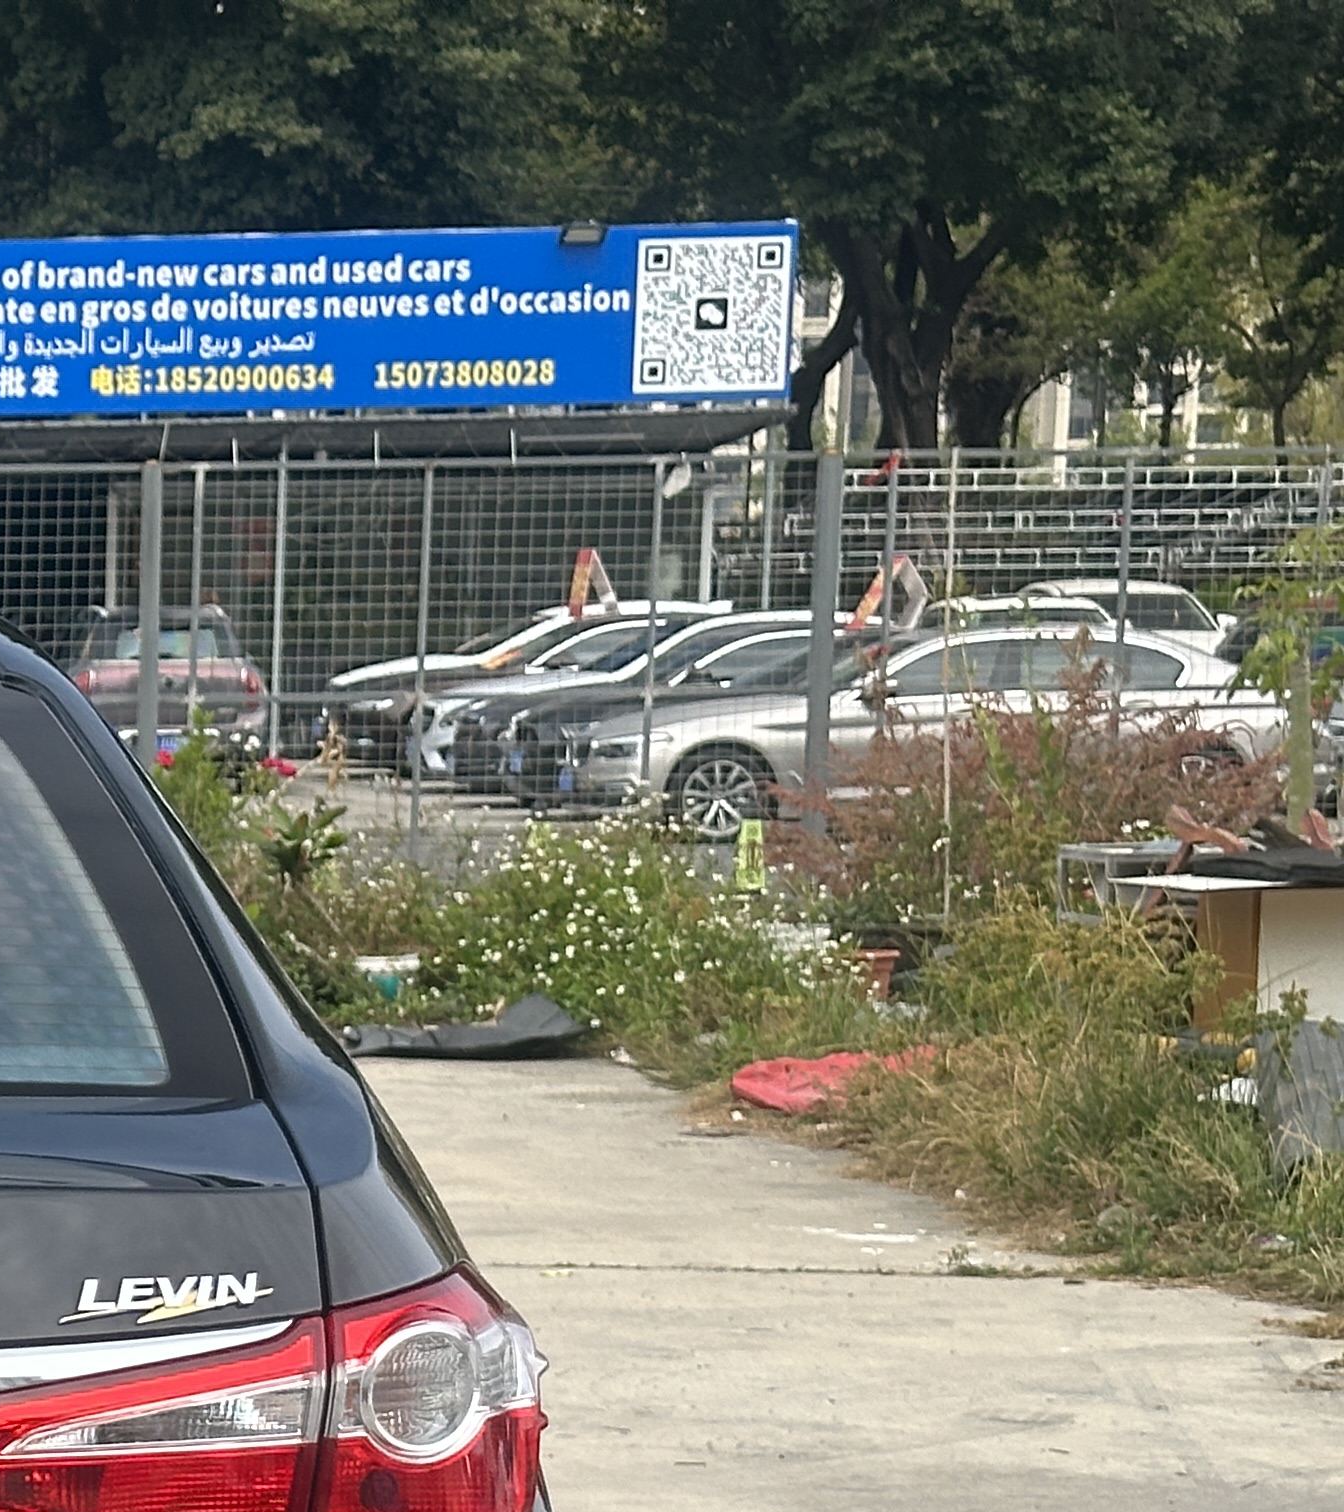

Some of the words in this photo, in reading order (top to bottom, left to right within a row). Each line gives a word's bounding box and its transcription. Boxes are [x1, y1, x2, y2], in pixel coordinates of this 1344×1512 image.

[2, 260, 35, 291] of
[38, 259, 200, 290] brand-new
[203, 261, 267, 287] cars
[271, 255, 328, 286] and
[331, 253, 404, 285] used
[408, 258, 472, 283] cars
[39, 301, 77, 323] en
[81, 300, 148, 328] gros
[151, 293, 189, 321] de
[192, 291, 319, 320] voitures
[323, 293, 430, 319] neuves
[434, 289, 466, 316] et
[469, 283, 631, 316] d'occasion
[23, 326, 95, 361] الجديدة
[99, 324, 196, 361] السيارات
[198, 331, 244, 360] وبيع
[246, 330, 317, 359] تصدير
[90, 363, 335, 396] 电话:18520900634
[373, 357, 555, 390] 15073808028
[76, 1271, 259, 1313] LEVIN
